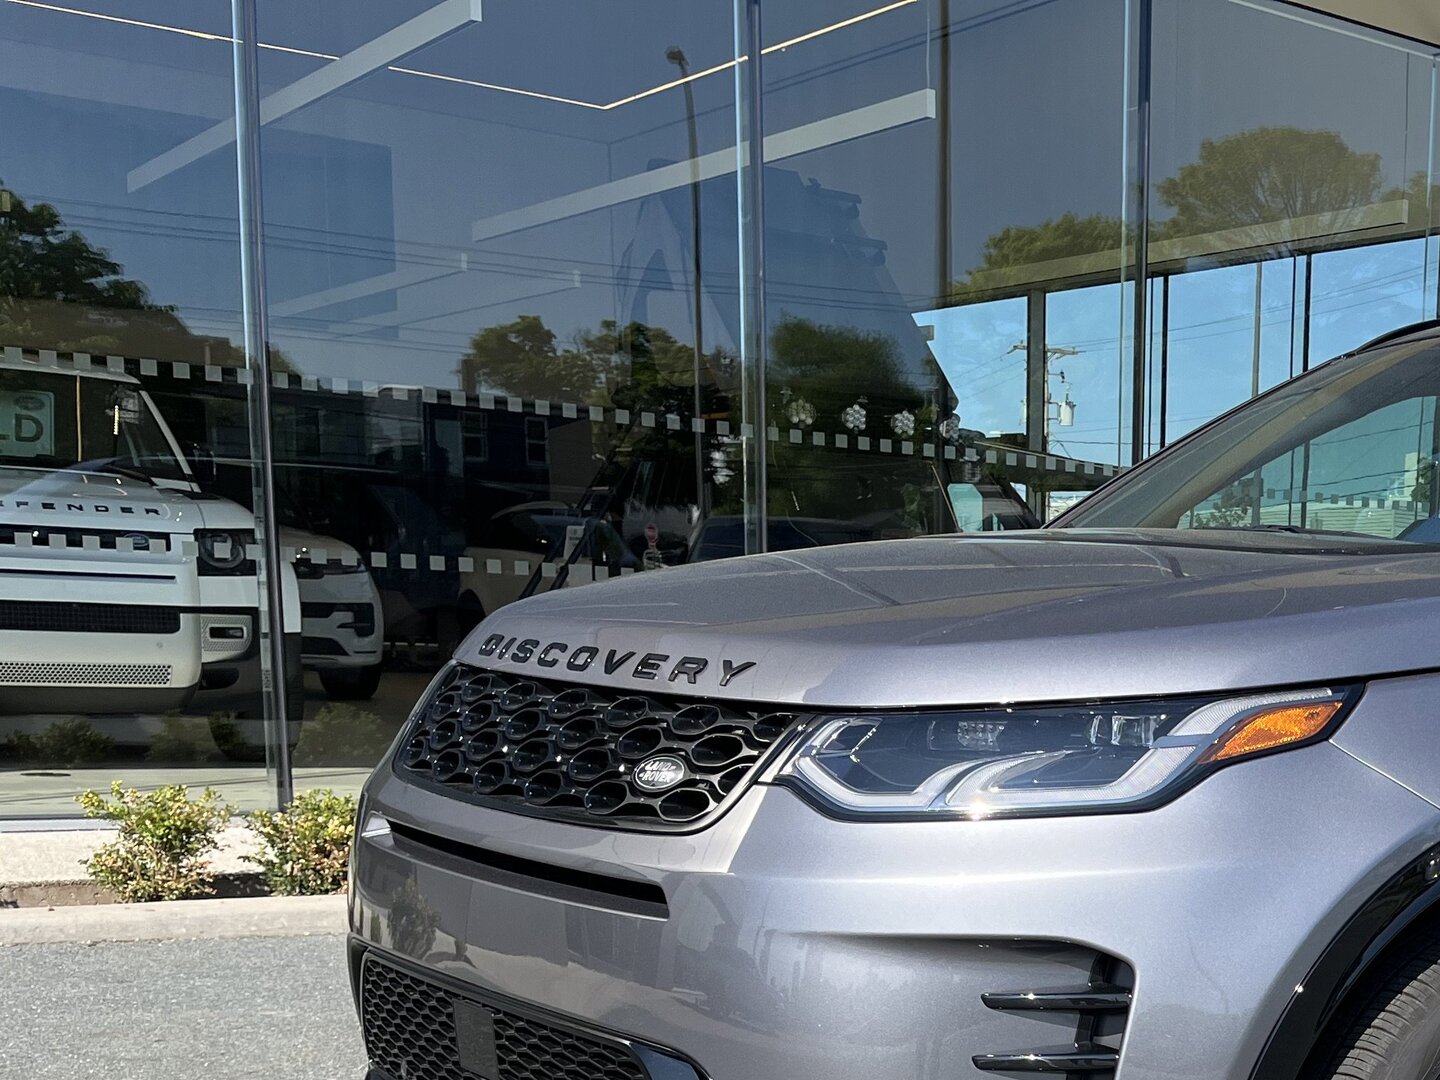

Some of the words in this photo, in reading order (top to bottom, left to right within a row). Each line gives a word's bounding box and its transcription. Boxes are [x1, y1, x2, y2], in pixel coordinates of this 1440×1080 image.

[0, 501, 161, 516] FENDER
[478, 633, 757, 687] DISCOVERY
[644, 761, 672, 771] LAND
[642, 771, 673, 783] ROVER
